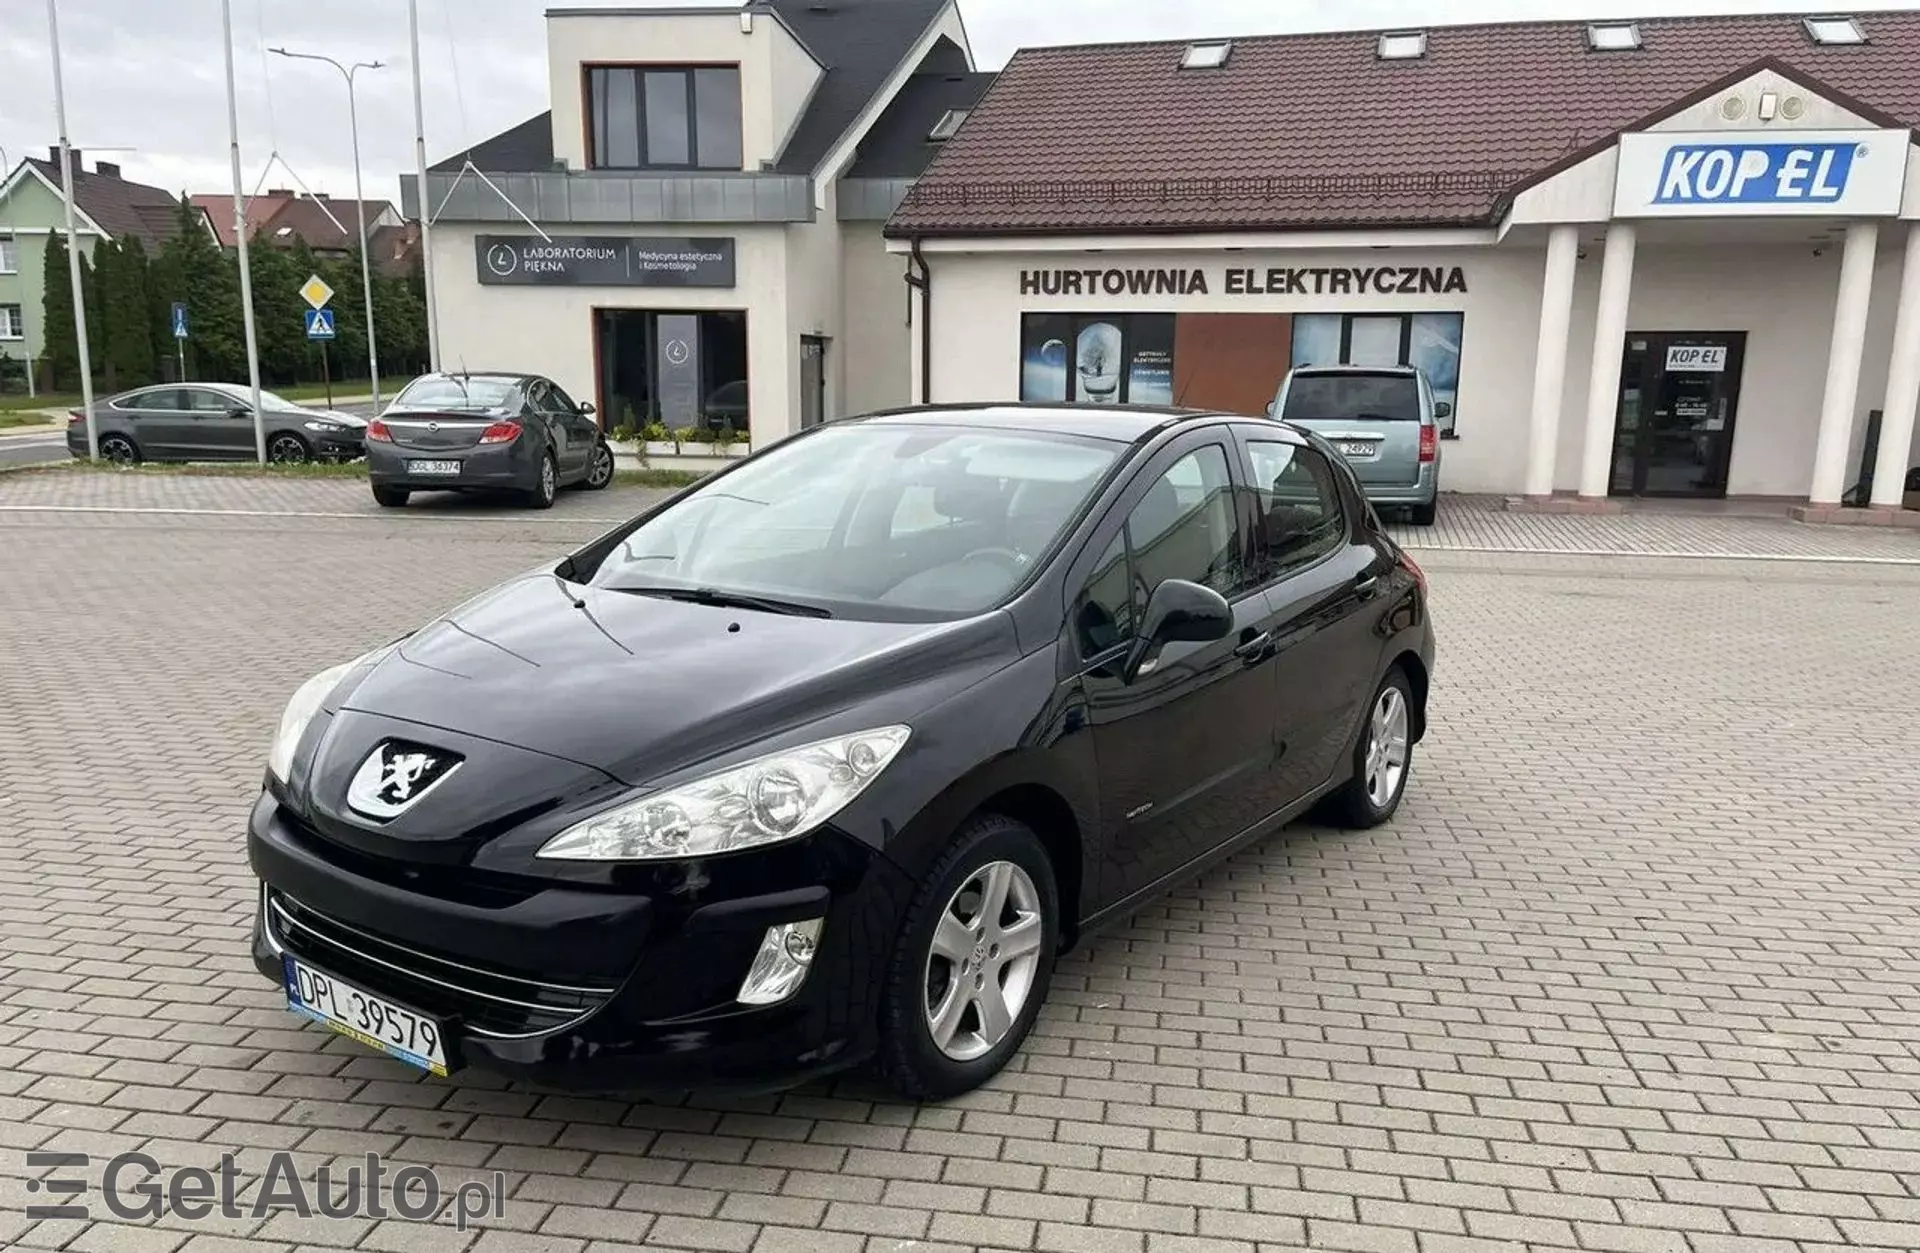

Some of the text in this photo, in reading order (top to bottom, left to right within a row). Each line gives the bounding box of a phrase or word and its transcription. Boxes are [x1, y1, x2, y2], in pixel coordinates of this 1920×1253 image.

[1661, 150, 1770, 199] KOP
[523, 247, 616, 260] LABORATORIUM
[639, 250, 722, 262] Medycyna estetyczna
[524, 260, 565, 273] PIĘKNA
[644, 261, 698, 272] Kosmetologia
[1020, 267, 1468, 295] HURTOWNIA ELEKTRYCZNA
[1669, 349, 1700, 363] KOP
[297, 963, 347, 1020] DPL
[352, 992, 437, 1056] 39579
